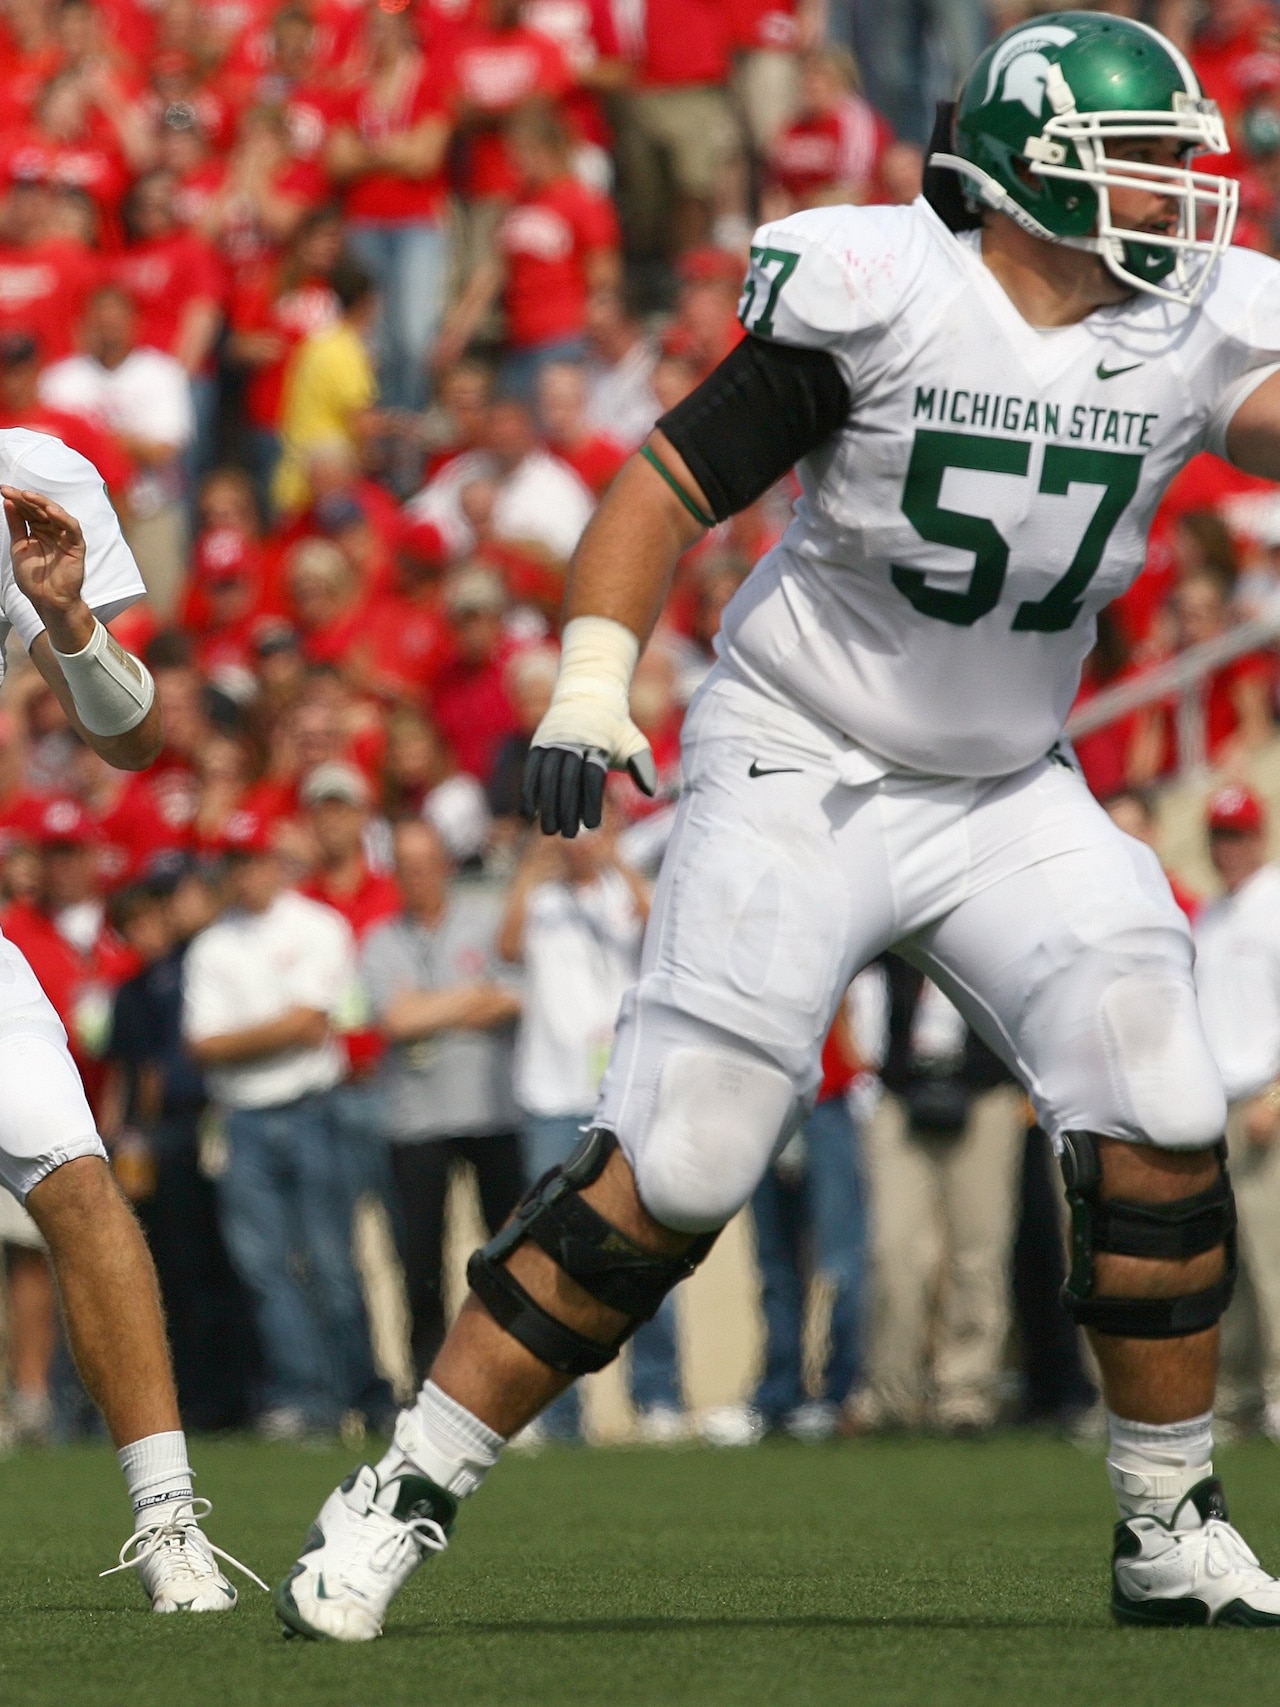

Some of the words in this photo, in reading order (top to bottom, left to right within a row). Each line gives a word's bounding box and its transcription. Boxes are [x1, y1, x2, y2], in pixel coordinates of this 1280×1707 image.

[913, 386, 1061, 436] MICHIGAN
[1069, 405, 1160, 448] STATE
[891, 428, 1146, 633] 57
